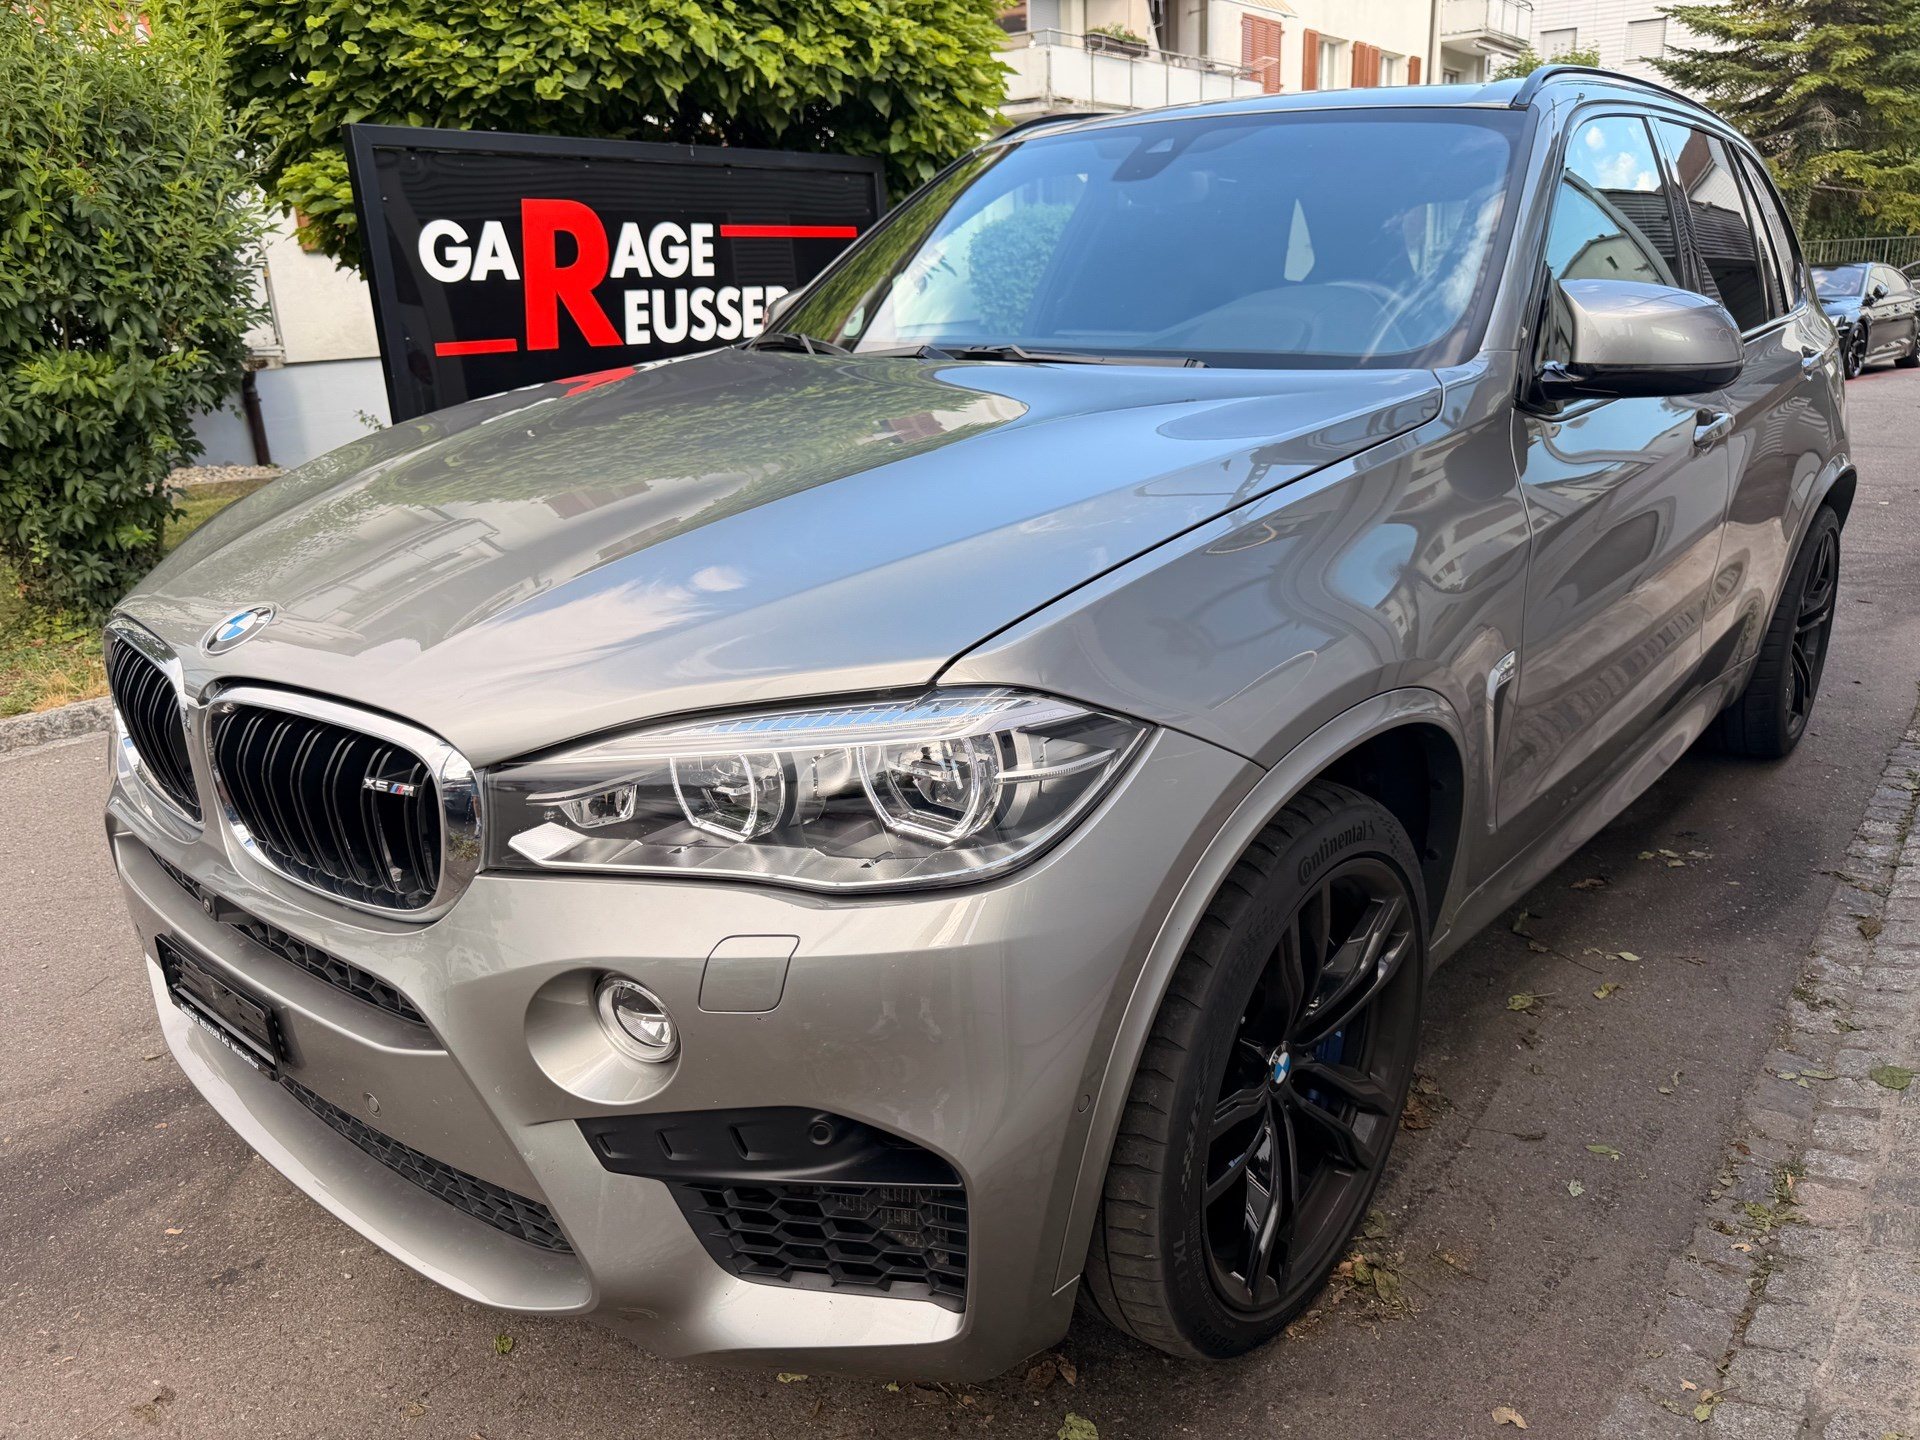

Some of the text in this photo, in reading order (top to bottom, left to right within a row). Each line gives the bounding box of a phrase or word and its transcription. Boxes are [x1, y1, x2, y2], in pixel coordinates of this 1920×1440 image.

[362, 777, 389, 792] X5
[1297, 820, 1366, 887] Continental
[221, 1035, 230, 1049] AG
